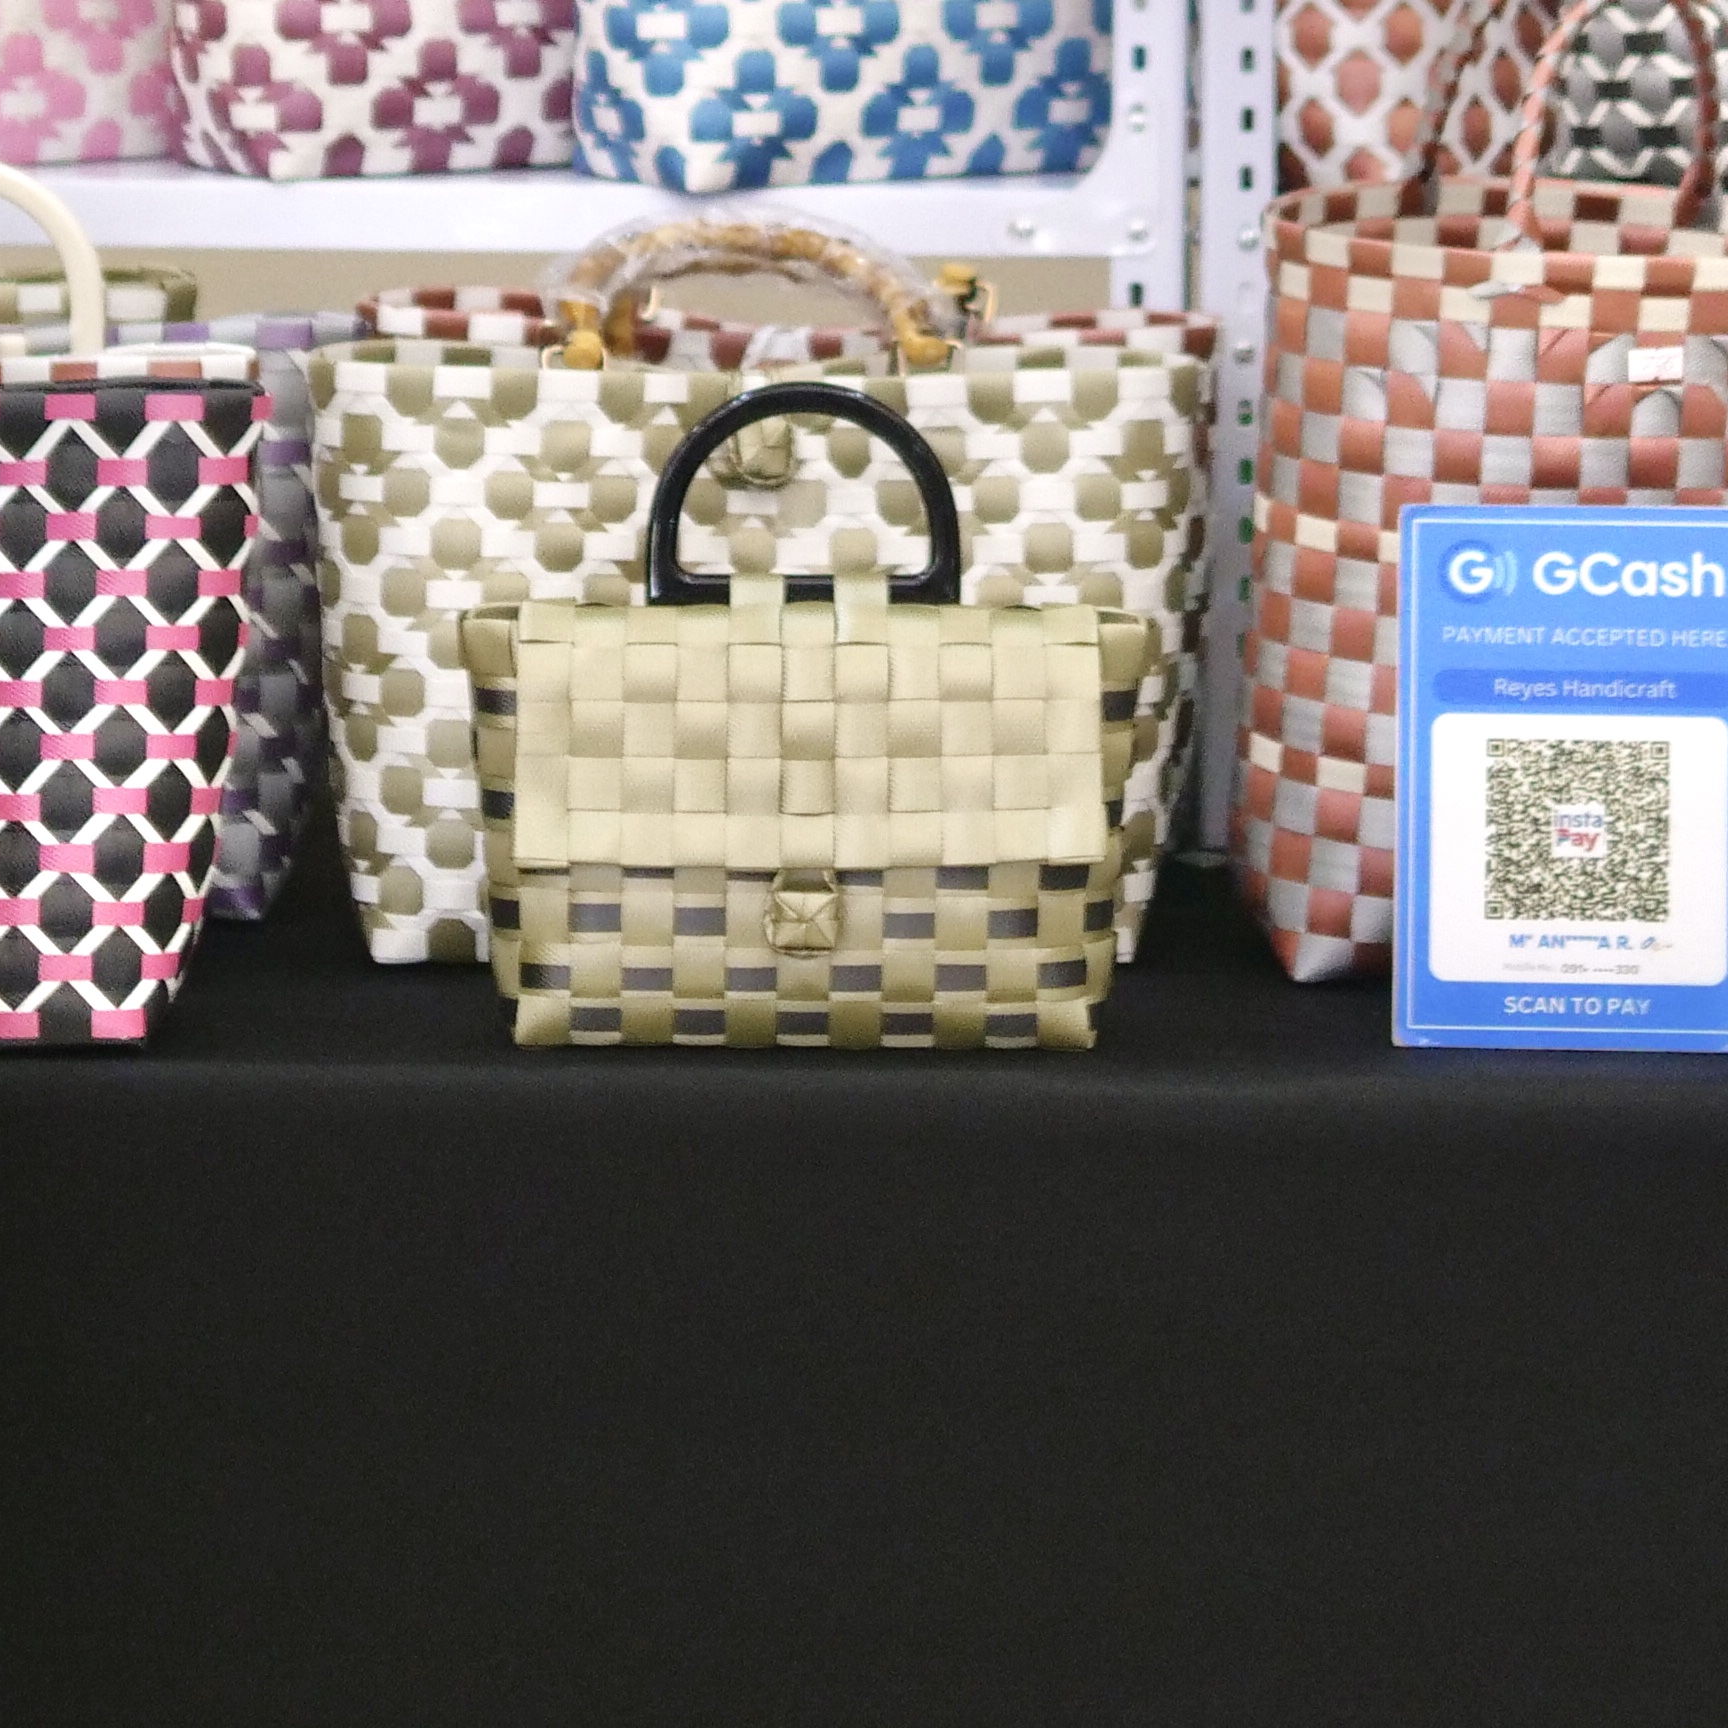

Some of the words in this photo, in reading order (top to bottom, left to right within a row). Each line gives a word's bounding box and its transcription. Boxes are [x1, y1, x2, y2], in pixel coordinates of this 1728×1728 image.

[1532, 550, 1726, 598] GCash
[1441, 624, 1546, 646] PAYMENT
[1549, 626, 1667, 648] ACCEPTED
[1671, 628, 1728, 649] HERE
[1493, 677, 1558, 702] Reyes
[1562, 677, 1678, 700] Handicraft
[1503, 995, 1566, 1015] SCAN
[1570, 996, 1603, 1015] TO
[1606, 997, 1652, 1016] PAY
